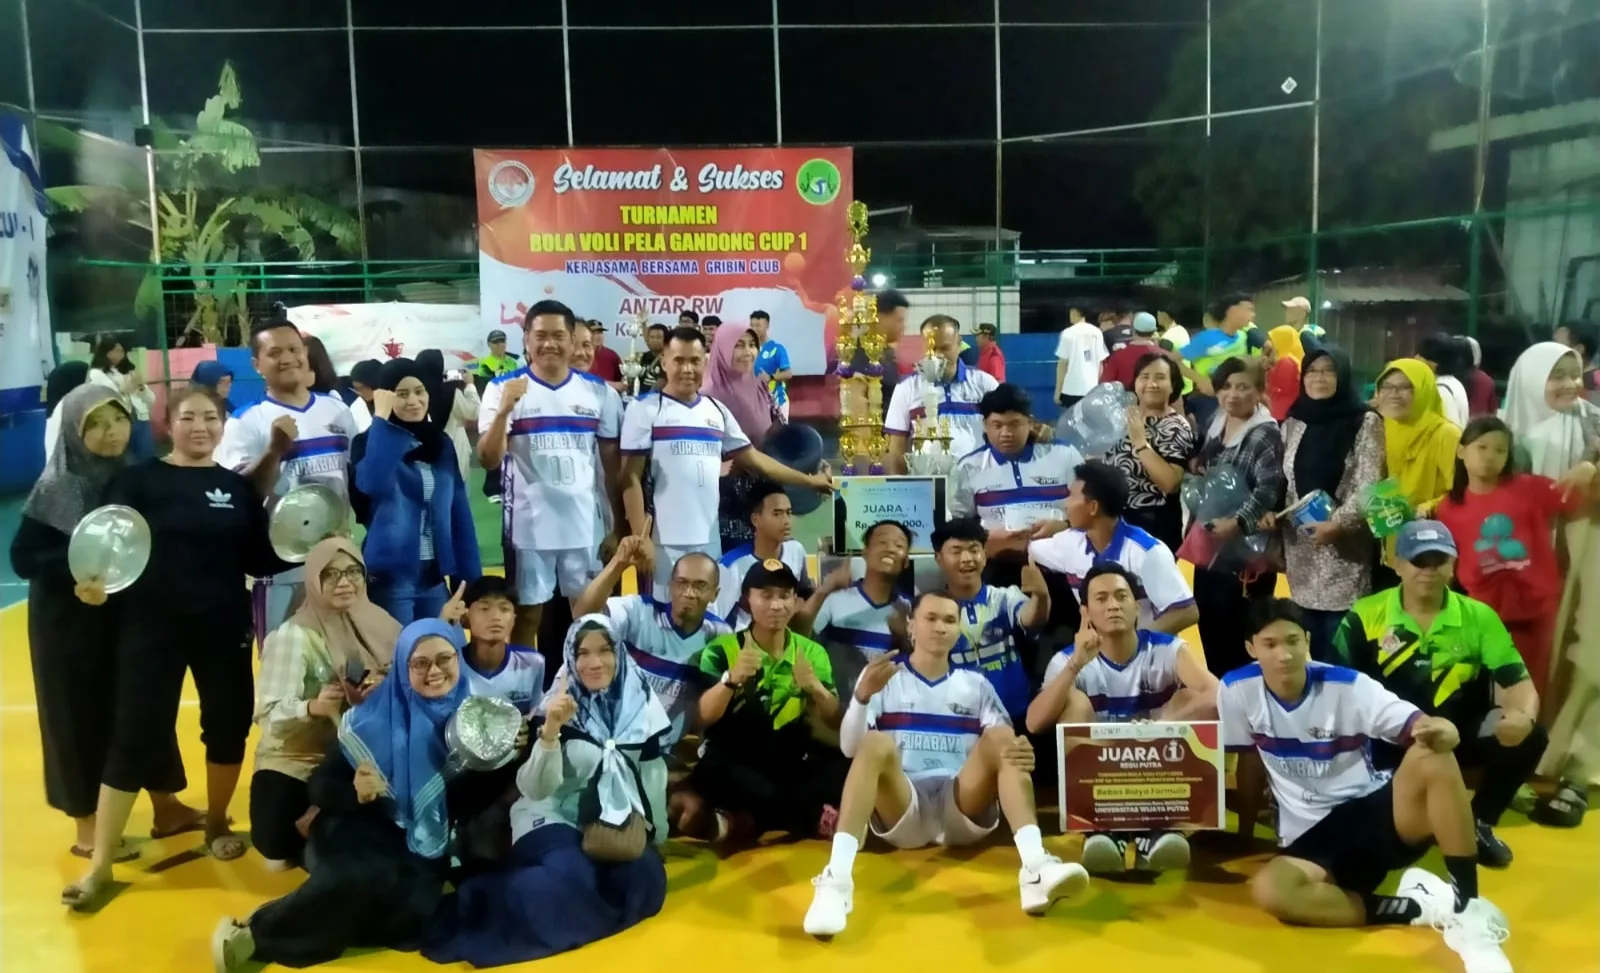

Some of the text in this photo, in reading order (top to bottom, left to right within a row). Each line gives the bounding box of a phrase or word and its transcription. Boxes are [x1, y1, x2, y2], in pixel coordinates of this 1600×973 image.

[553, 164, 662, 194] Selamat
[670, 166, 689, 192] &
[698, 163, 784, 193] Sukses
[620, 205, 718, 225] TURNAMEN
[530, 231, 807, 252] BOLA VOLI PELA GANDONG CUP 1
[566, 260, 780, 274] KERJASAMA BERSAMA GRIBIN CLUB
[619, 297, 724, 315] ANTAR RW
[548, 455, 576, 486] 10
[863, 504, 903, 513] JUARA
[1097, 747, 1161, 762] JUARA
